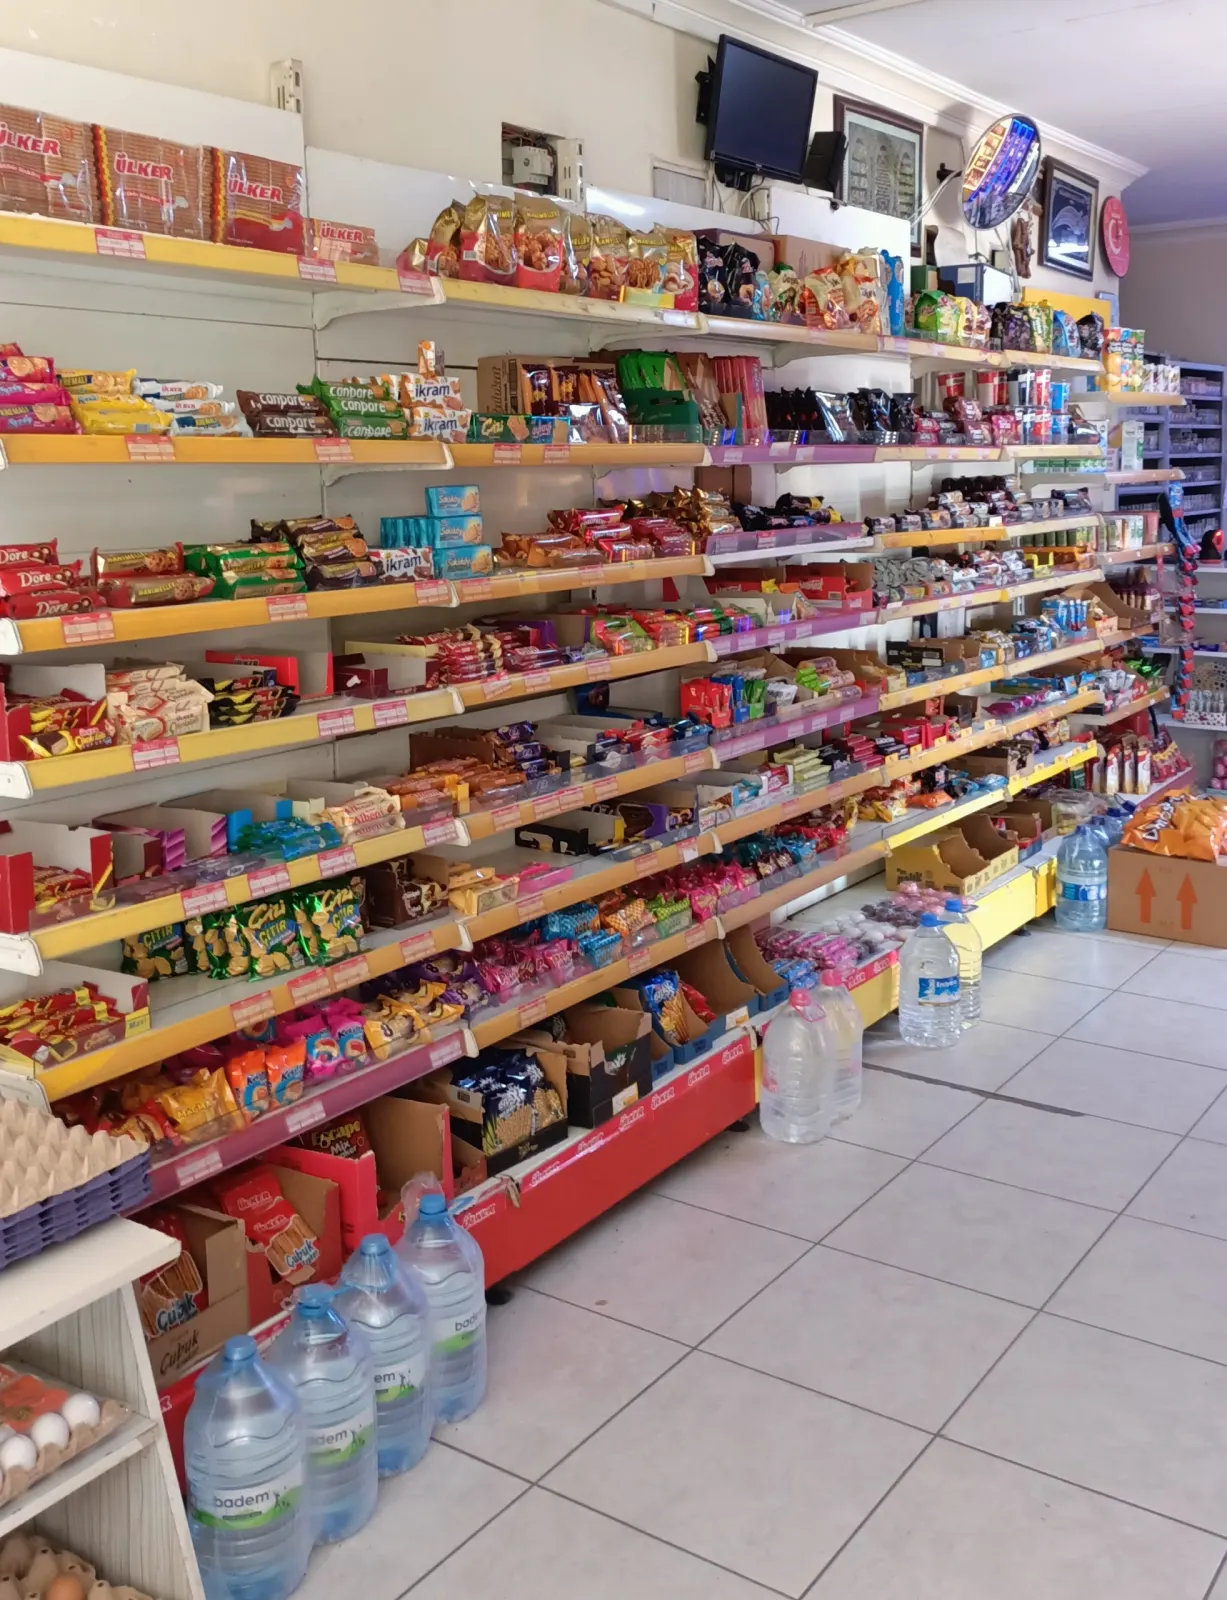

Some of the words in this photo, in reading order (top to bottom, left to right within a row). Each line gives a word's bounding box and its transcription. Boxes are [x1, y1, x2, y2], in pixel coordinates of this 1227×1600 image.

[115, 153, 173, 181] ÜLKER
[227, 173, 283, 203] ÜLKER
[321, 222, 363, 242] ÜLKER
[329, 385, 374, 401] canpare
[415, 383, 450, 398] ikram
[260, 392, 304, 407] canpare
[341, 399, 385, 414] canpare
[266, 414, 316, 433] canpare
[347, 421, 391, 439] canpare
[423, 416, 458, 432] ikram
[0, 550, 28, 563] Dore
[383, 555, 422, 573] ikram
[17, 571, 52, 586] Dore
[35, 600, 69, 617] Dore
[353, 810, 384, 824] Albeni
[312, 1120, 361, 1149] Escape
[331, 1138, 351, 1155] Mix
[237, 1191, 272, 1211] ÜLKER
[214, 1491, 270, 1509] badem
